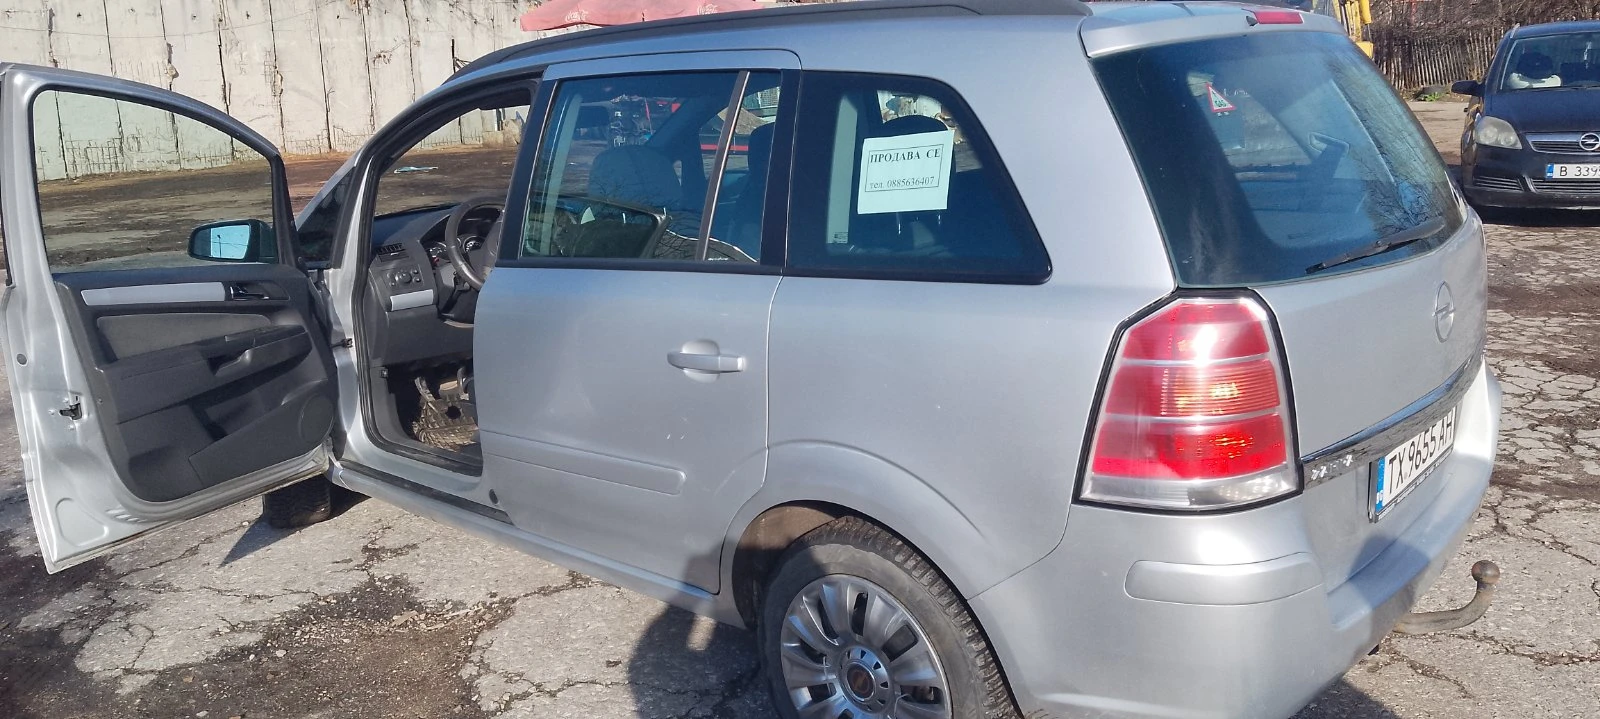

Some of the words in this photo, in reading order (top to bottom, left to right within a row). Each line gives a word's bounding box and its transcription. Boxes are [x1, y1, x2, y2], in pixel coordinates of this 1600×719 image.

[870, 151, 921, 163] ПРОДАВА
[926, 148, 941, 159] СЕ
[1559, 165, 1568, 177] B
[1574, 165, 1600, 177] 339
[1408, 423, 1437, 478] 9655
